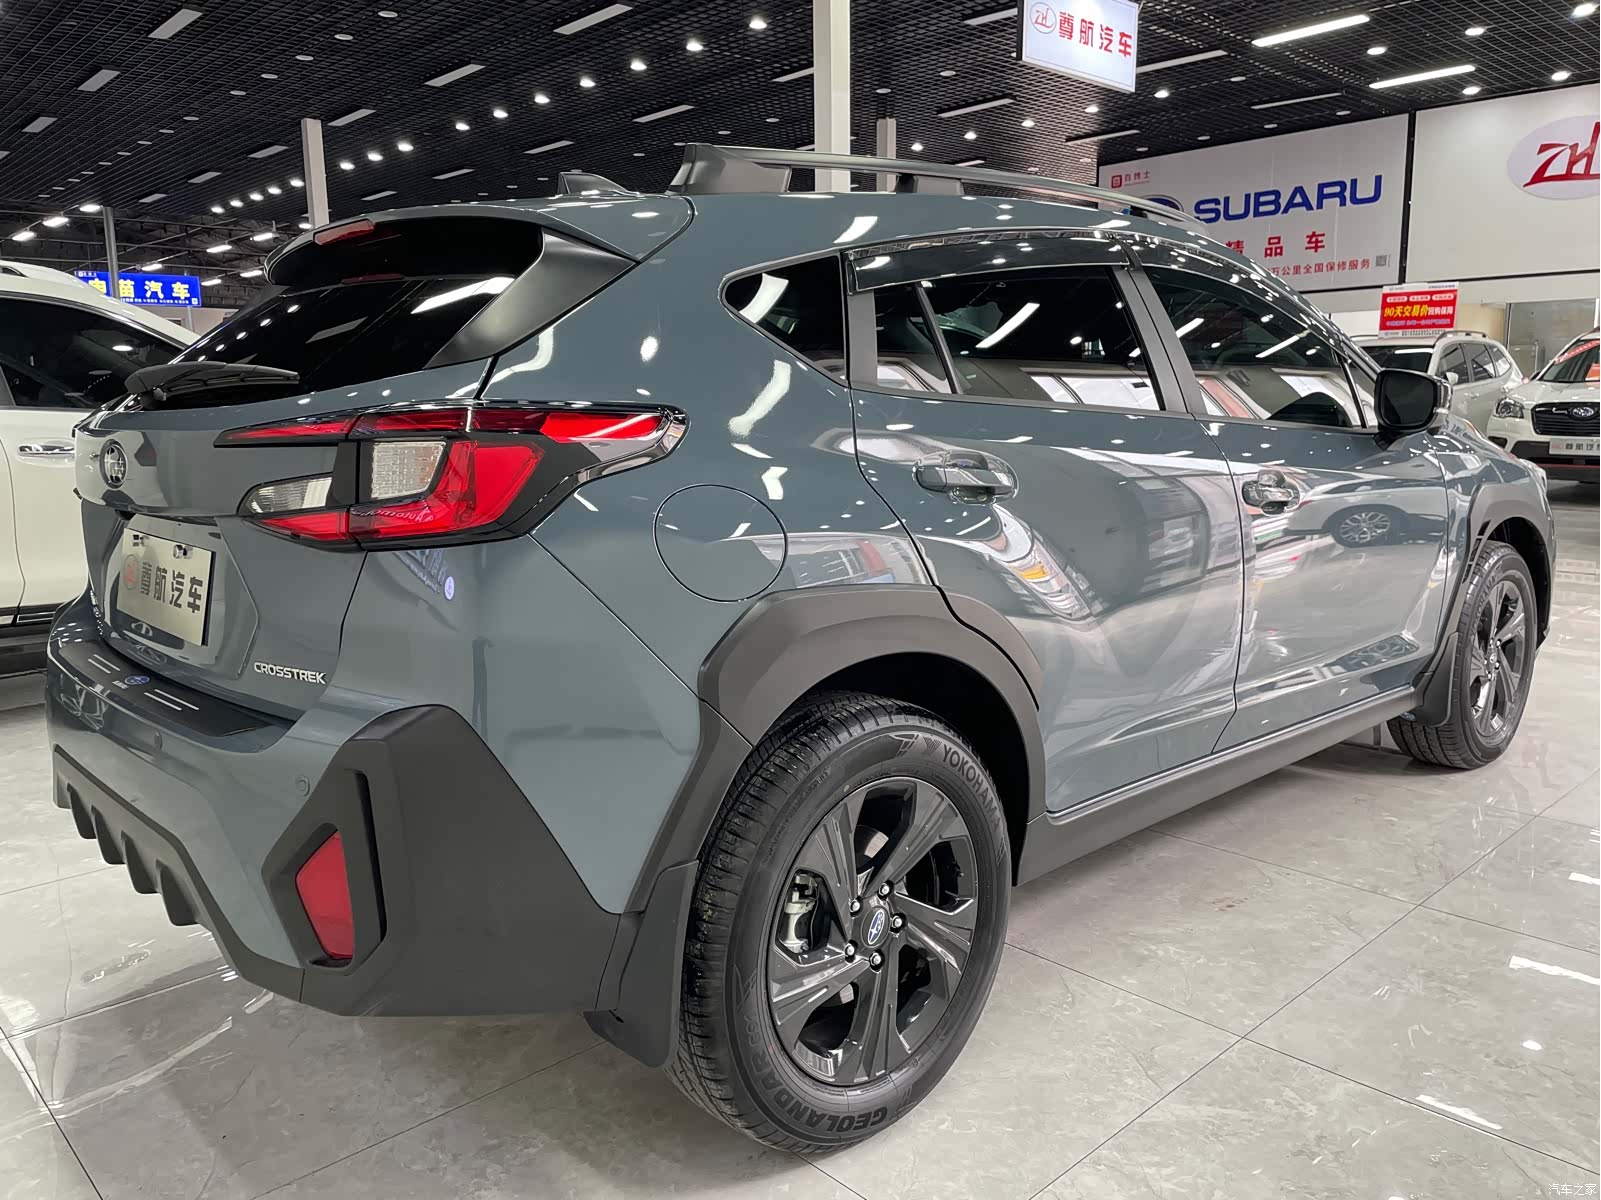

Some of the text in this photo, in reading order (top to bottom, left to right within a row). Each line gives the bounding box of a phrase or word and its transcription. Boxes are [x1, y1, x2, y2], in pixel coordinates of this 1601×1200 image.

[1058, 11, 1132, 57] 尊航汽车
[1194, 174, 1382, 224] SUBARU
[1268, 258, 1370, 276] 万公里全国保修服务
[140, 561, 203, 613] 尊航汽车
[254, 662, 327, 684] CROSSTREK
[943, 743, 1001, 833] YOKOHAMA
